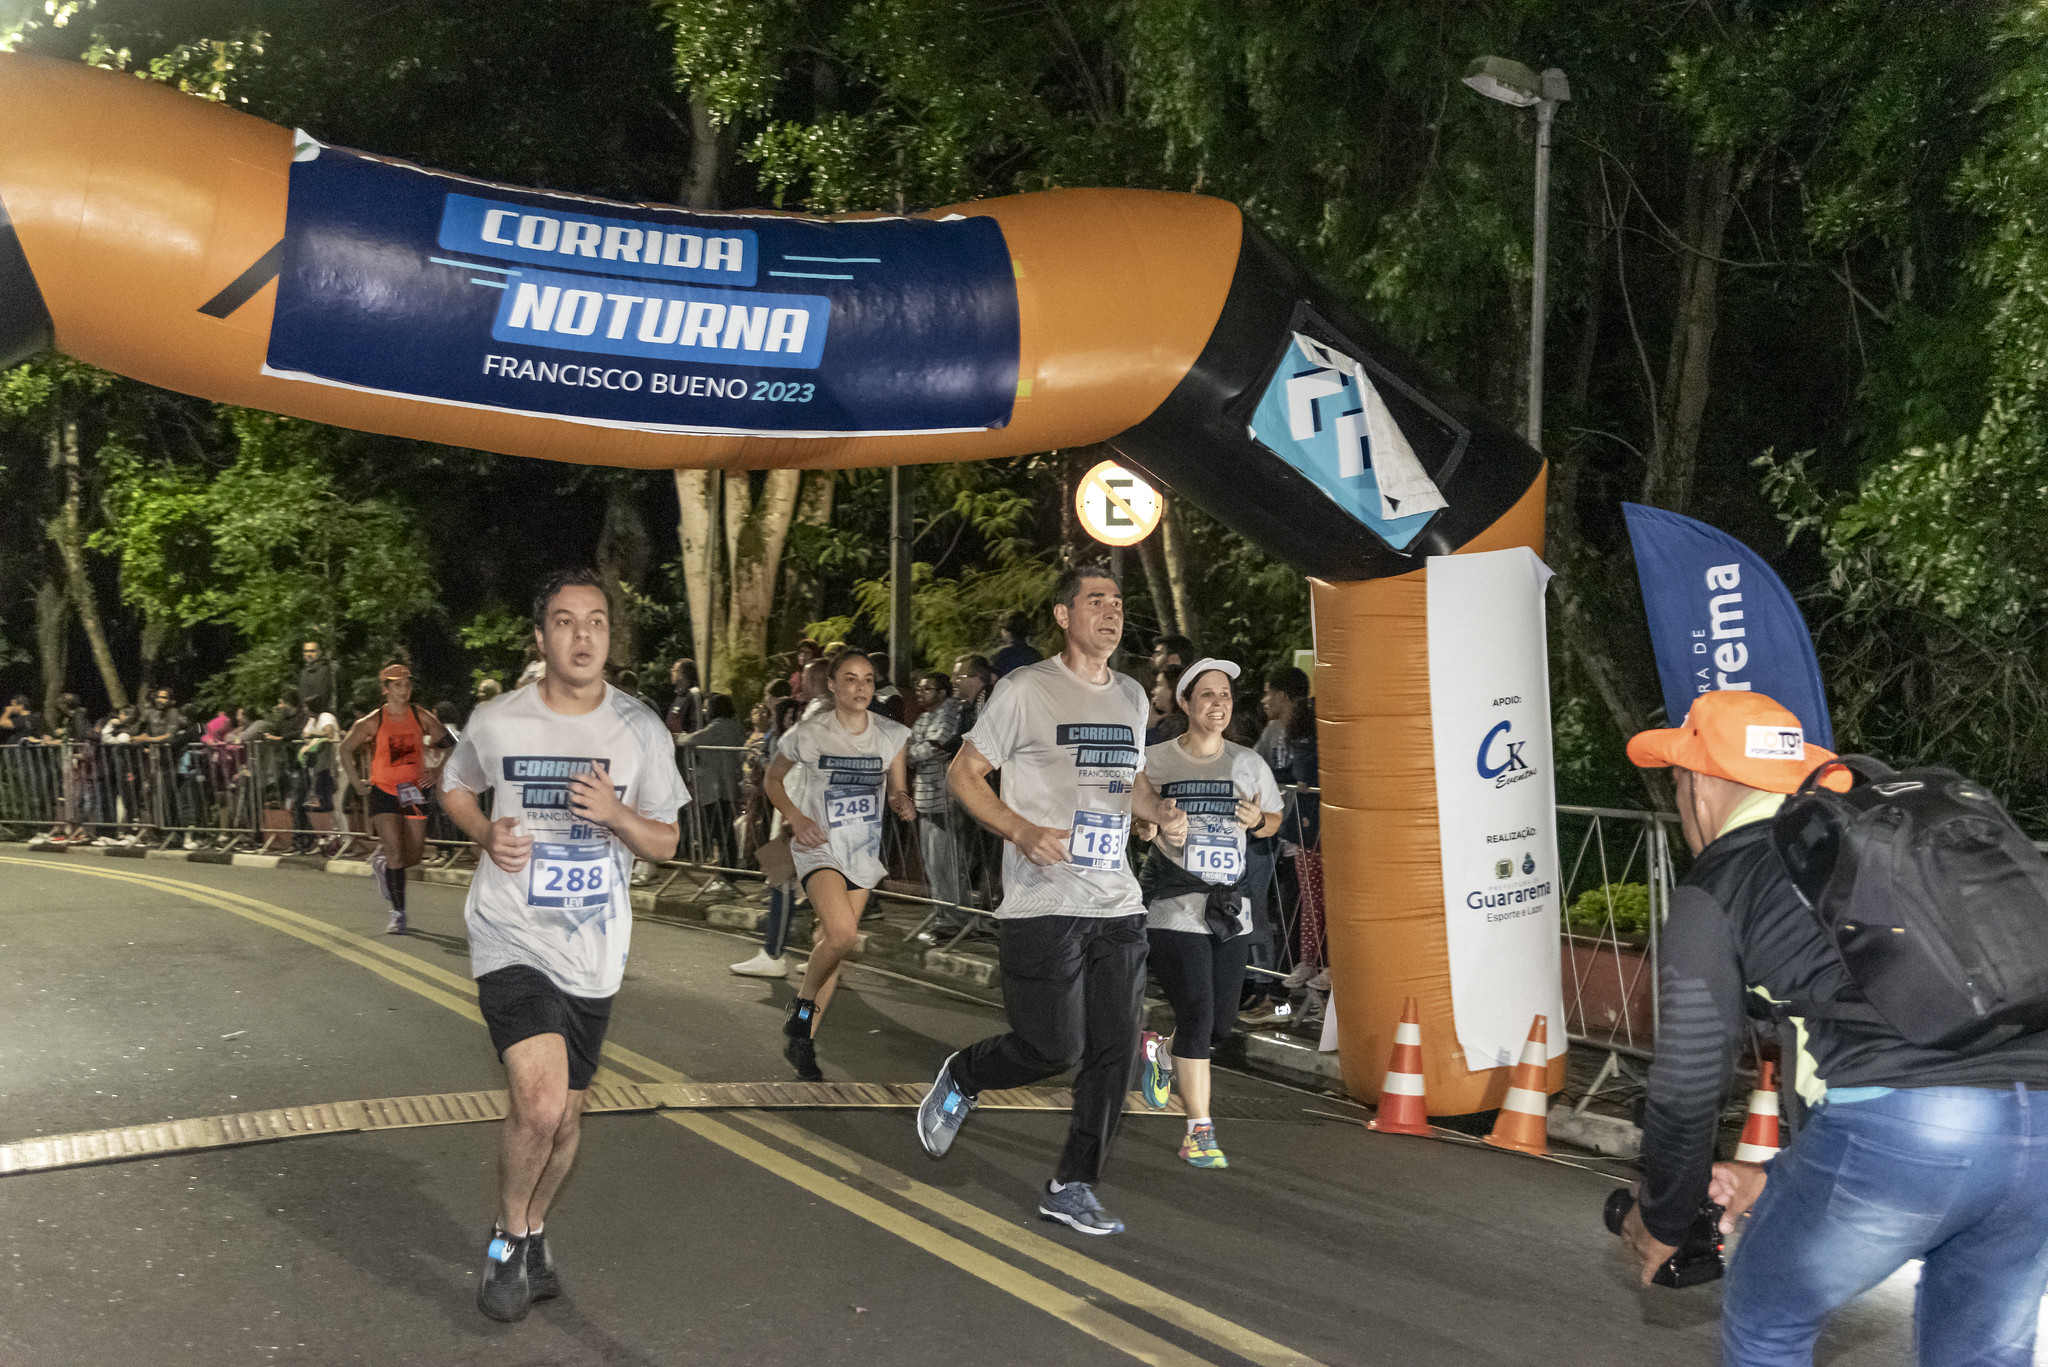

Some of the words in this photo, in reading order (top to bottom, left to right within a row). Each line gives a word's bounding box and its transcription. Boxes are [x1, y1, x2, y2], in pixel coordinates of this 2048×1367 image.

[481, 208, 744, 272] CORRIDA
[507, 282, 811, 353] NOTURNA
[482, 354, 643, 392] FRANCISCO
[649, 373, 748, 400] BUENO
[751, 381, 816, 404] 2023
[1105, 479, 1134, 526] E
[1691, 629, 1707, 654] DE
[1493, 695, 1522, 707] APOIO:
[1068, 727, 1133, 742] CORRIDA
[1080, 749, 1139, 765] NOTURN
[1476, 720, 1529, 779] CK
[514, 760, 605, 777] CORRID
[1078, 769, 1121, 778] FRANCISCO
[1495, 767, 1538, 789] Eventos
[1168, 782, 1231, 795] CORRIDA
[834, 798, 870, 817] 248
[1177, 800, 1237, 813] NOTURN
[1084, 831, 1120, 855] 183
[1196, 850, 1235, 869] 165
[545, 865, 603, 892] 288
[1466, 881, 1551, 910] Guararema
[1487, 910, 1521, 923] Esporte
